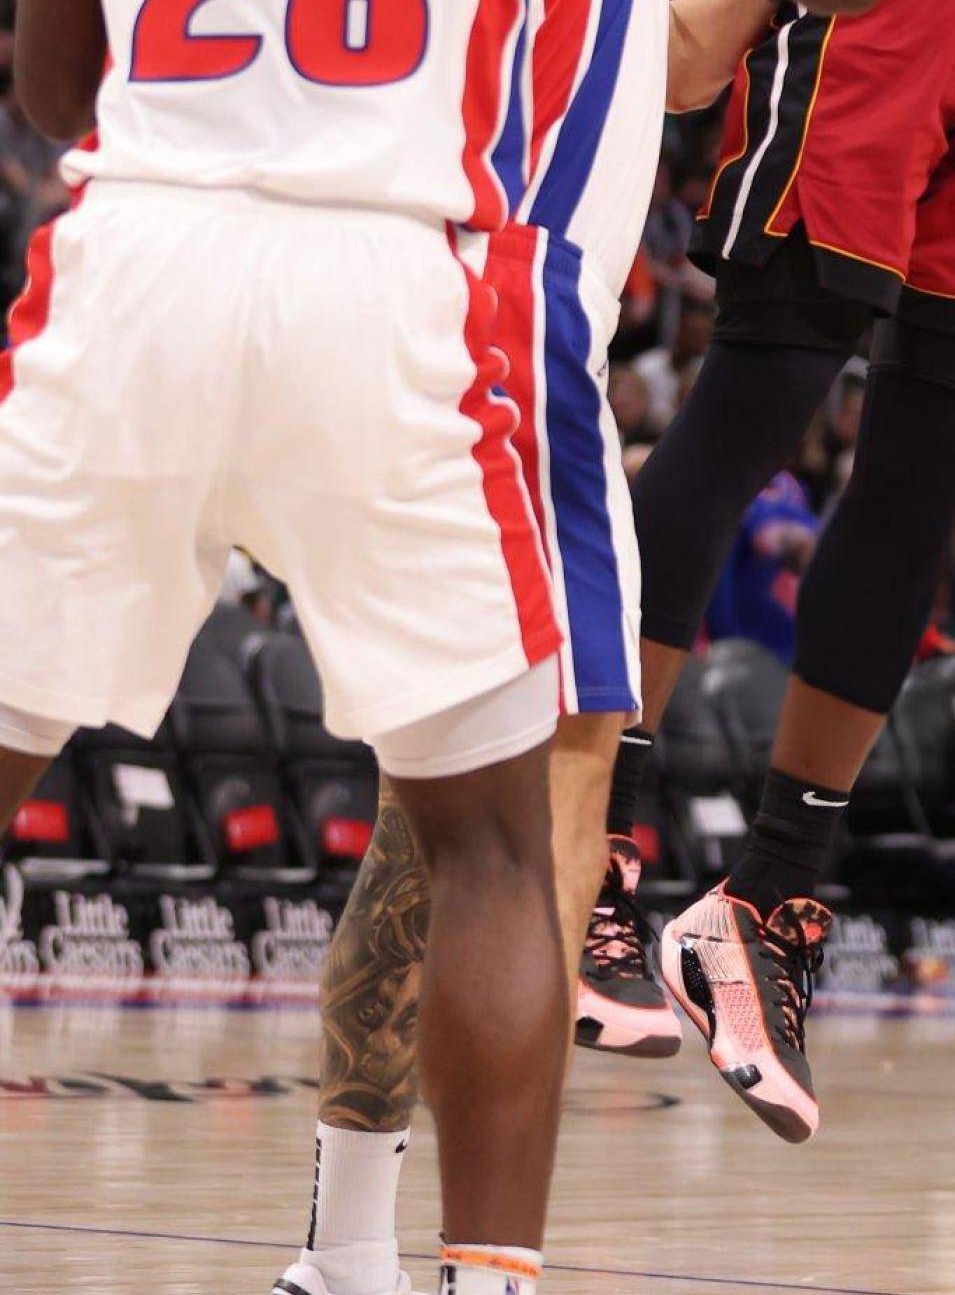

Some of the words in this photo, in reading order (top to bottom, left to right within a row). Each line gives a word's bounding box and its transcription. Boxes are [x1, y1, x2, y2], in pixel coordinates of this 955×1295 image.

[54, 890, 129, 937] Little
[159, 894, 235, 940] Little
[263, 896, 335, 941] Little
